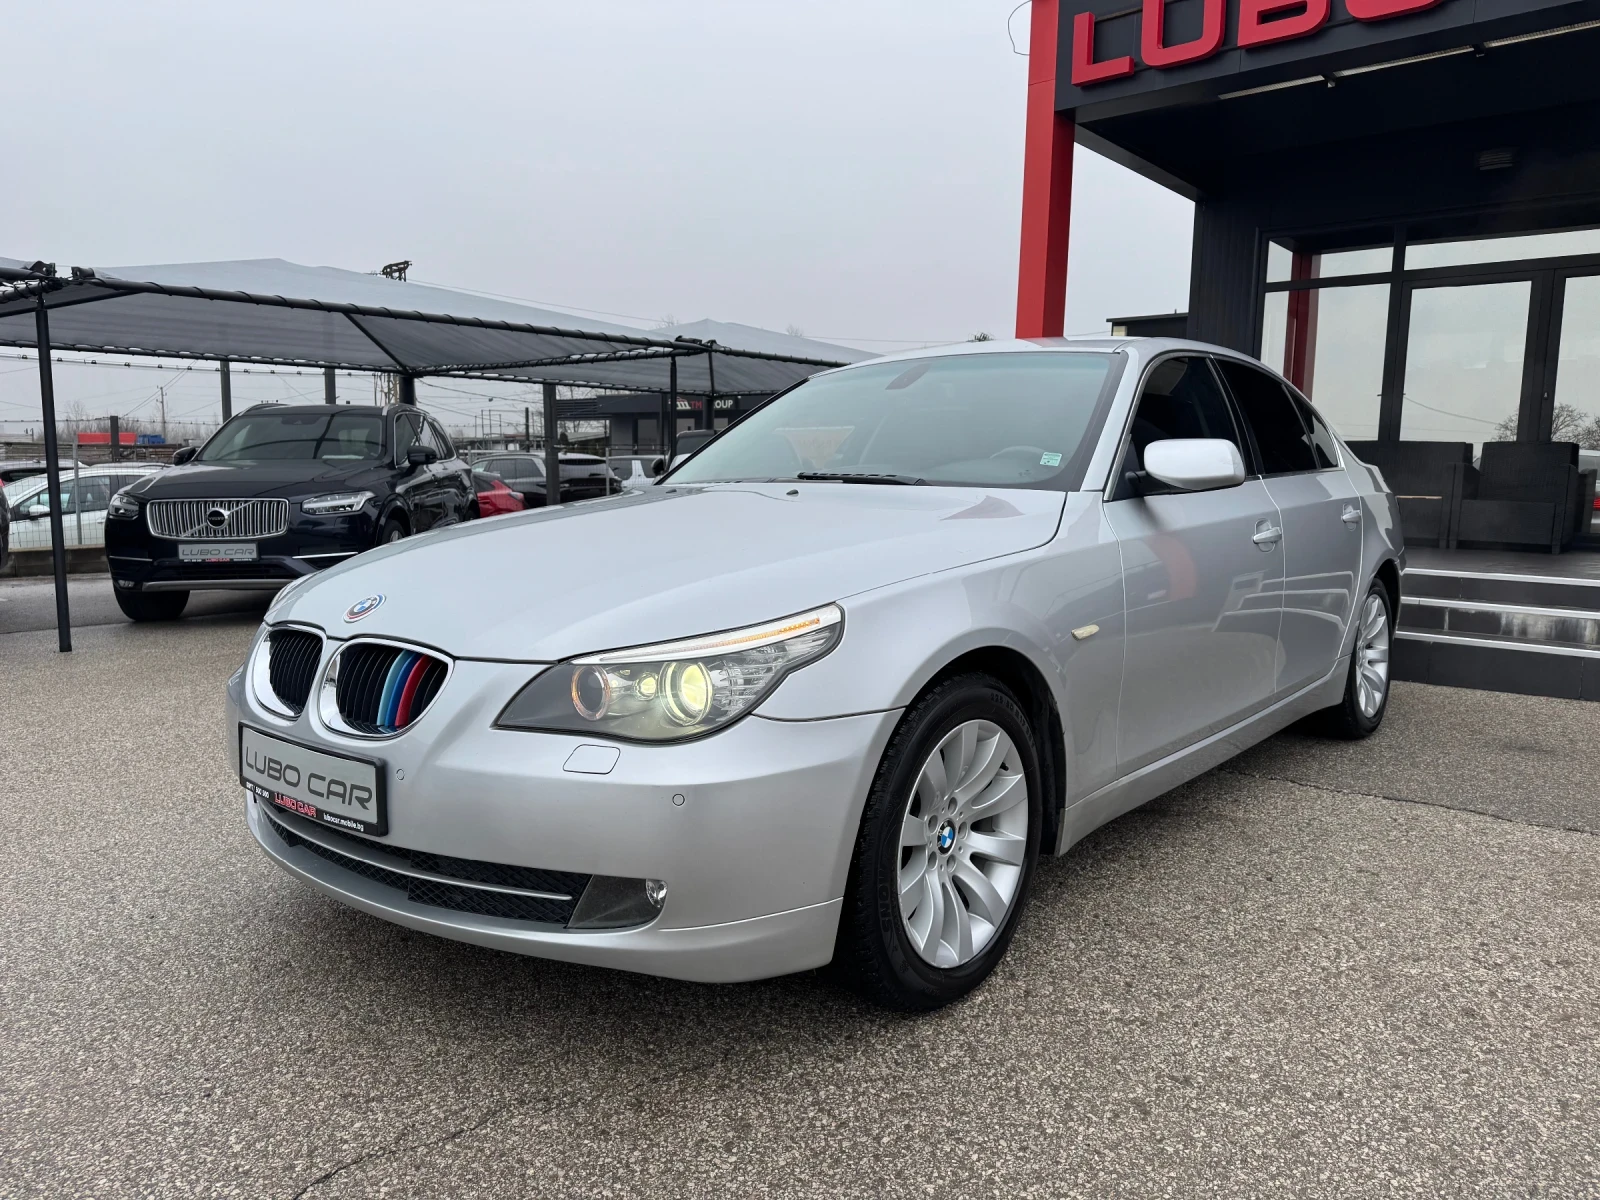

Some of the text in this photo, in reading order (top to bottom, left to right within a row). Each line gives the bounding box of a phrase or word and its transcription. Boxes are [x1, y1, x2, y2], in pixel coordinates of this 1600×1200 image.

[1071, 0, 1442, 87] LUB
[690, 401, 703, 409] TM
[181, 548, 255, 556] LUBO CAR
[245, 746, 373, 811] LUBO CAR
